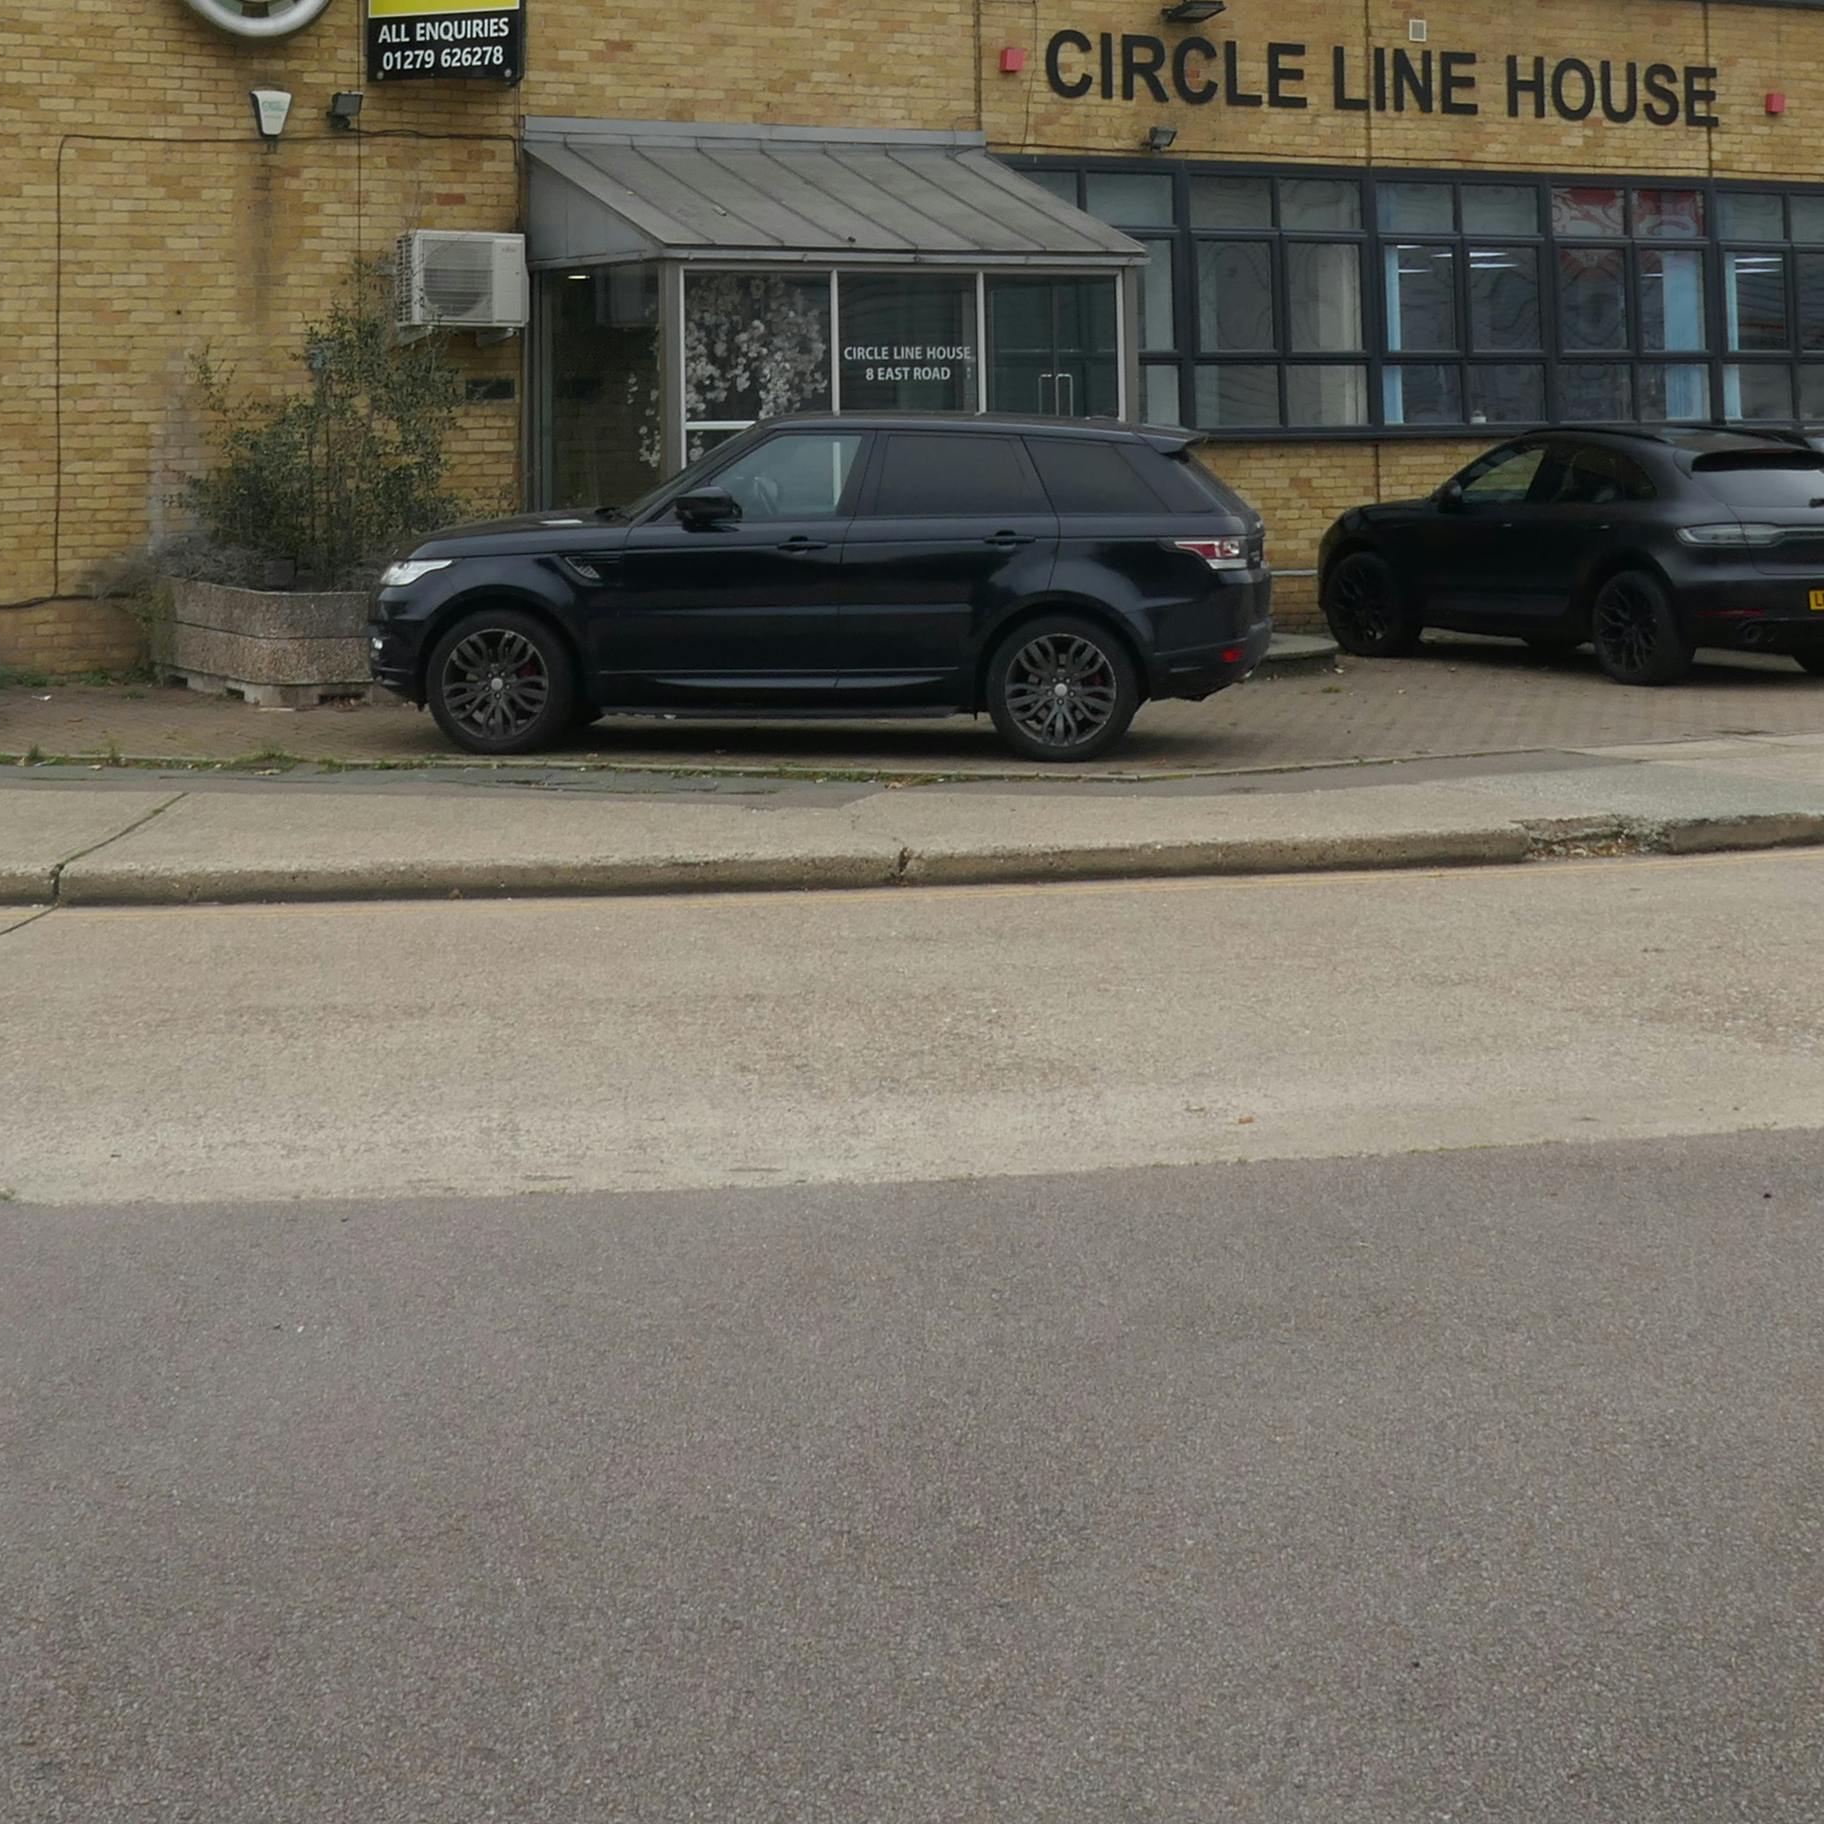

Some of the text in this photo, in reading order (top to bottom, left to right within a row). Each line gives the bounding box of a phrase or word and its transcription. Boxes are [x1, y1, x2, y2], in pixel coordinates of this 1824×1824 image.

[378, 17, 509, 44] ALL ENQUIRIES
[382, 45, 504, 70] 01279 626278
[1045, 29, 1719, 127] CIRCLE LINE HOUSE
[844, 346, 971, 360] CIRCLE LINE HOUSE
[865, 367, 951, 381] 8 EAST ROAD
